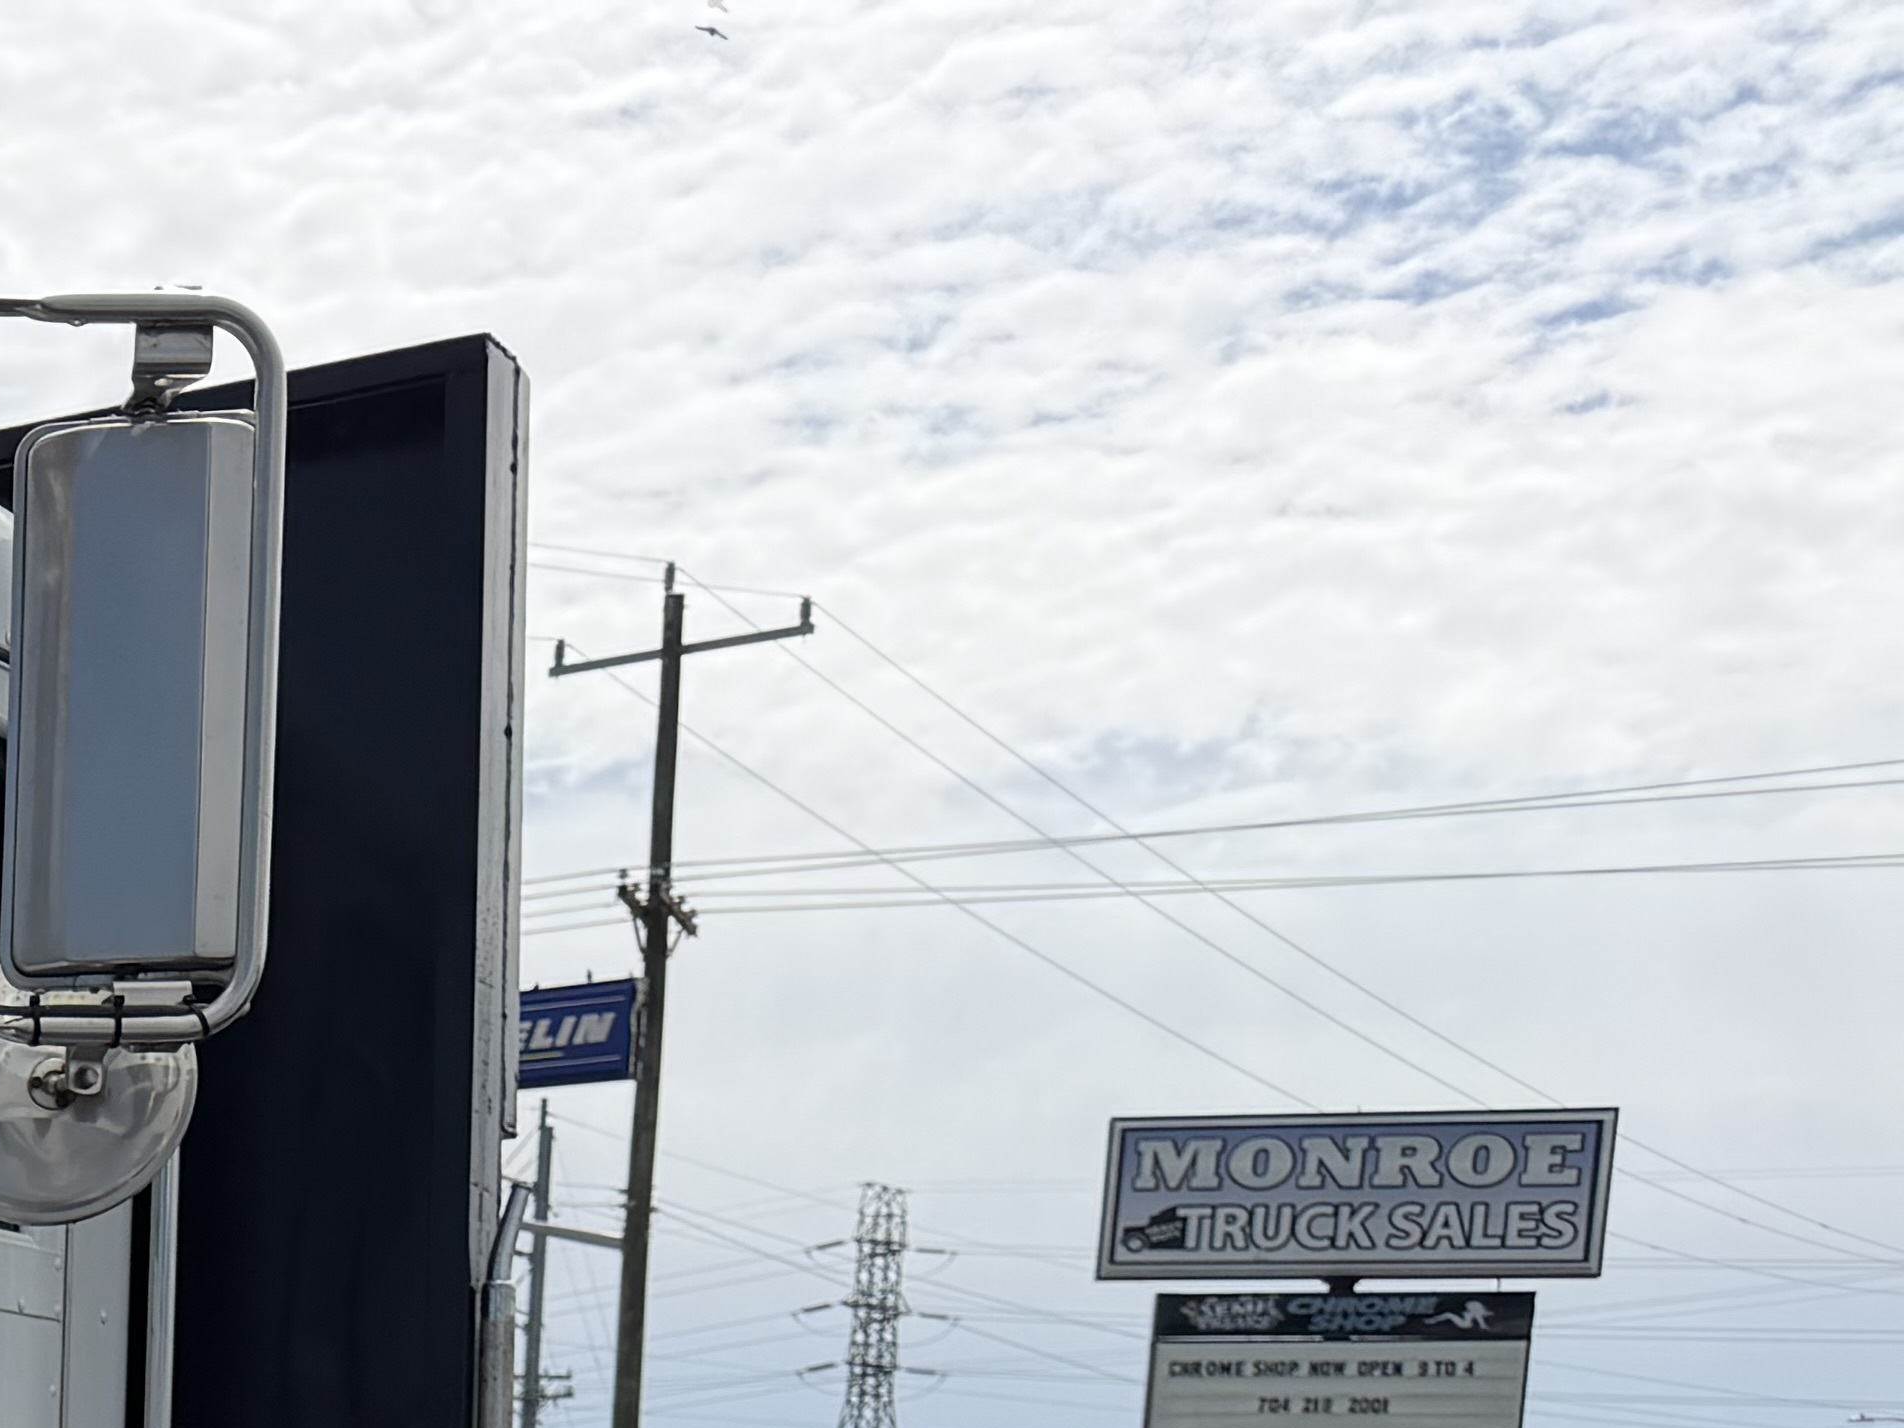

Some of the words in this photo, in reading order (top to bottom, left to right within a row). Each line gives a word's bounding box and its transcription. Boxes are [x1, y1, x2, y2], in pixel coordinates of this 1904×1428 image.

[1133, 1132, 1586, 1192] MONROE
[1175, 1202, 1379, 1250] TRUCK
[1385, 1201, 1578, 1250] SALES
[1168, 1360, 1246, 1377] CHROME
[1252, 1360, 1299, 1377] SHOP
[1308, 1360, 1347, 1377] NOW
[1357, 1360, 1403, 1377] OPEN
[1434, 1360, 1457, 1377] TO
[1463, 1360, 1474, 1377] 4
[1257, 1396, 1290, 1414] 704
